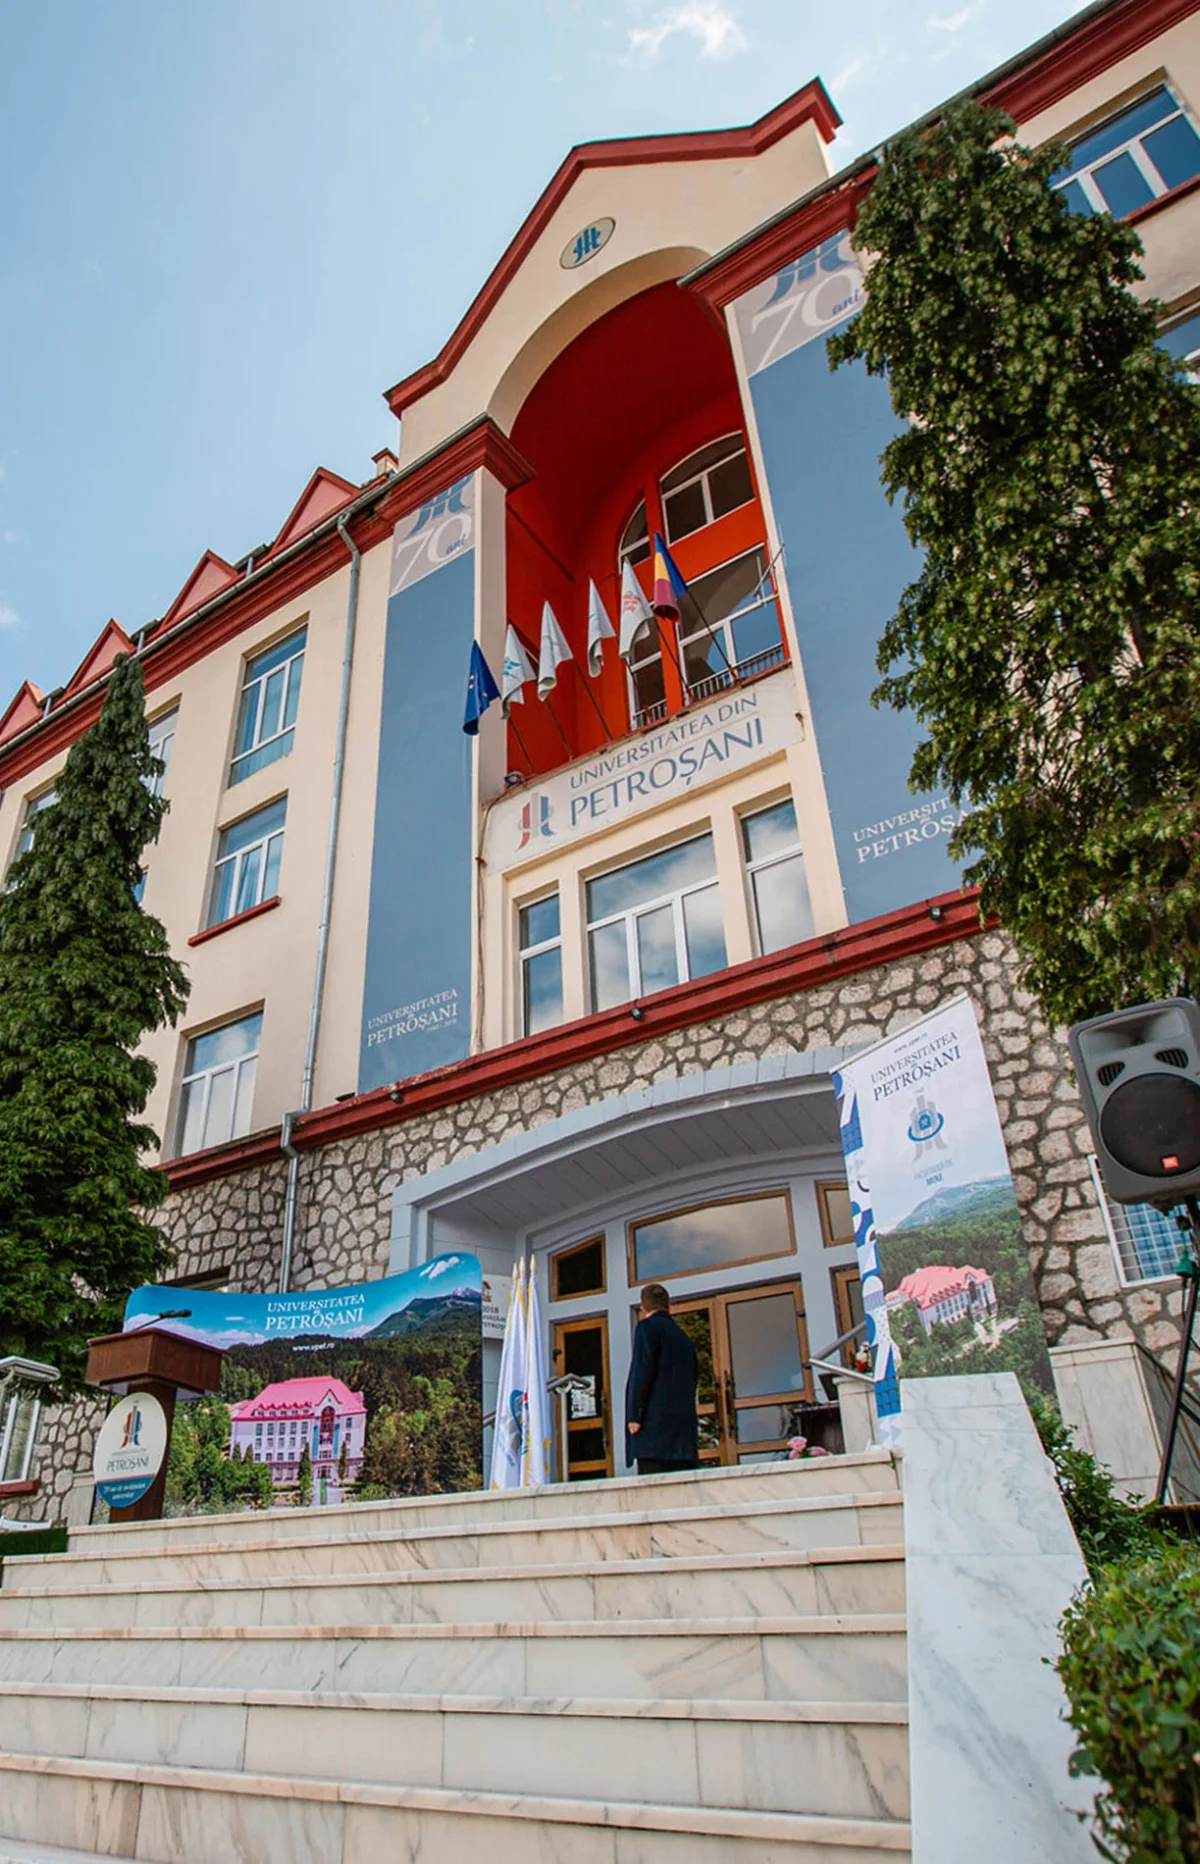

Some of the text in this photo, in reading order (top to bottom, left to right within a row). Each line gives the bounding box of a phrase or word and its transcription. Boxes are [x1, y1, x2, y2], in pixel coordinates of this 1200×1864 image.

[570, 692, 757, 789] UNIVERSITATEA DIN
[570, 717, 763, 827] PETROȘANI
[367, 988, 458, 1029] UNIVERSITATEA
[367, 1003, 457, 1048] PETROȘANI
[870, 1031, 959, 1084] UNIVERSITATEA
[872, 1046, 962, 1102] PETROȘANI
[264, 1307, 364, 1331] PETROȘANI
[267, 1293, 365, 1313] UNIVERSITATEA
